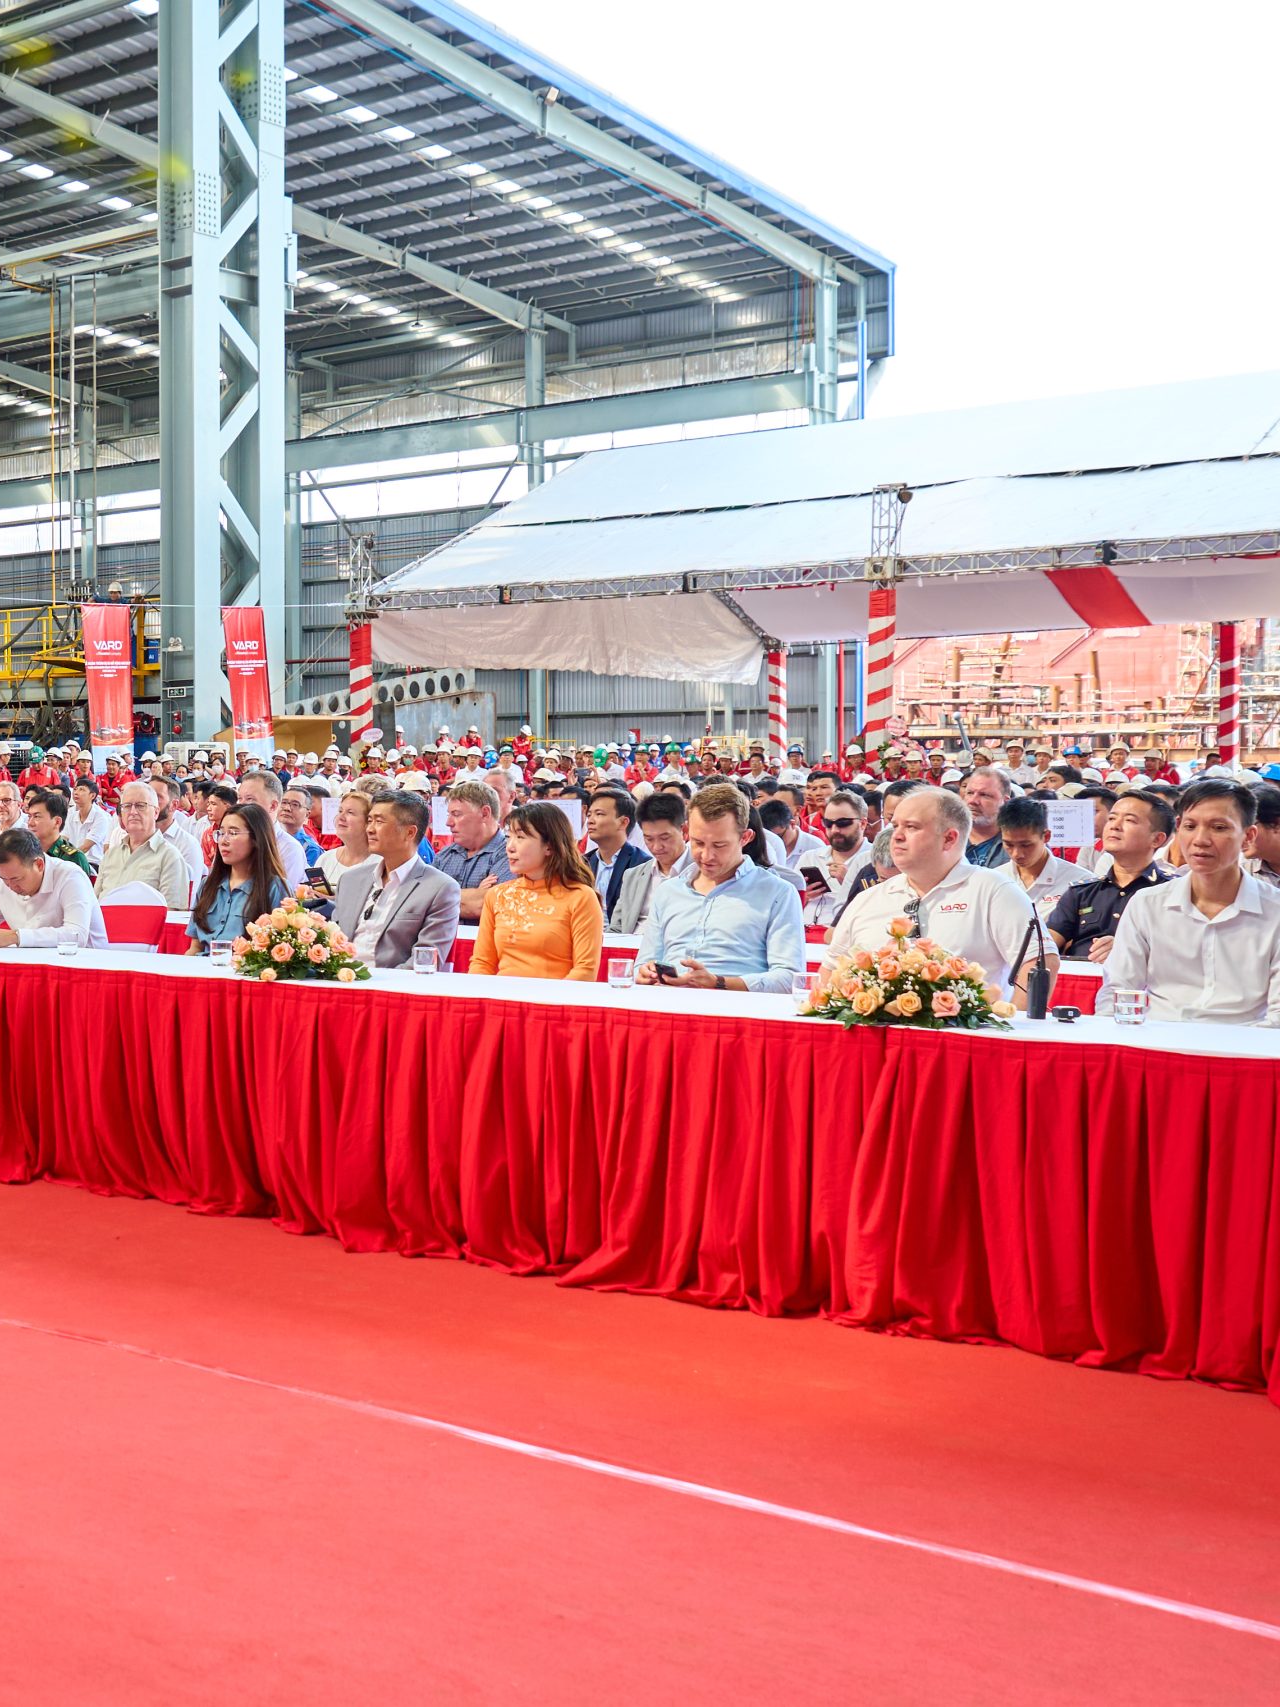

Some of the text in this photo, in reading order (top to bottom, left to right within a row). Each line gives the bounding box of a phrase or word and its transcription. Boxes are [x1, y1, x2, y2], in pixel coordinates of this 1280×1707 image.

[93, 640, 122, 651] VARD
[231, 640, 259, 651] VARD
[940, 903, 968, 911] VARD
